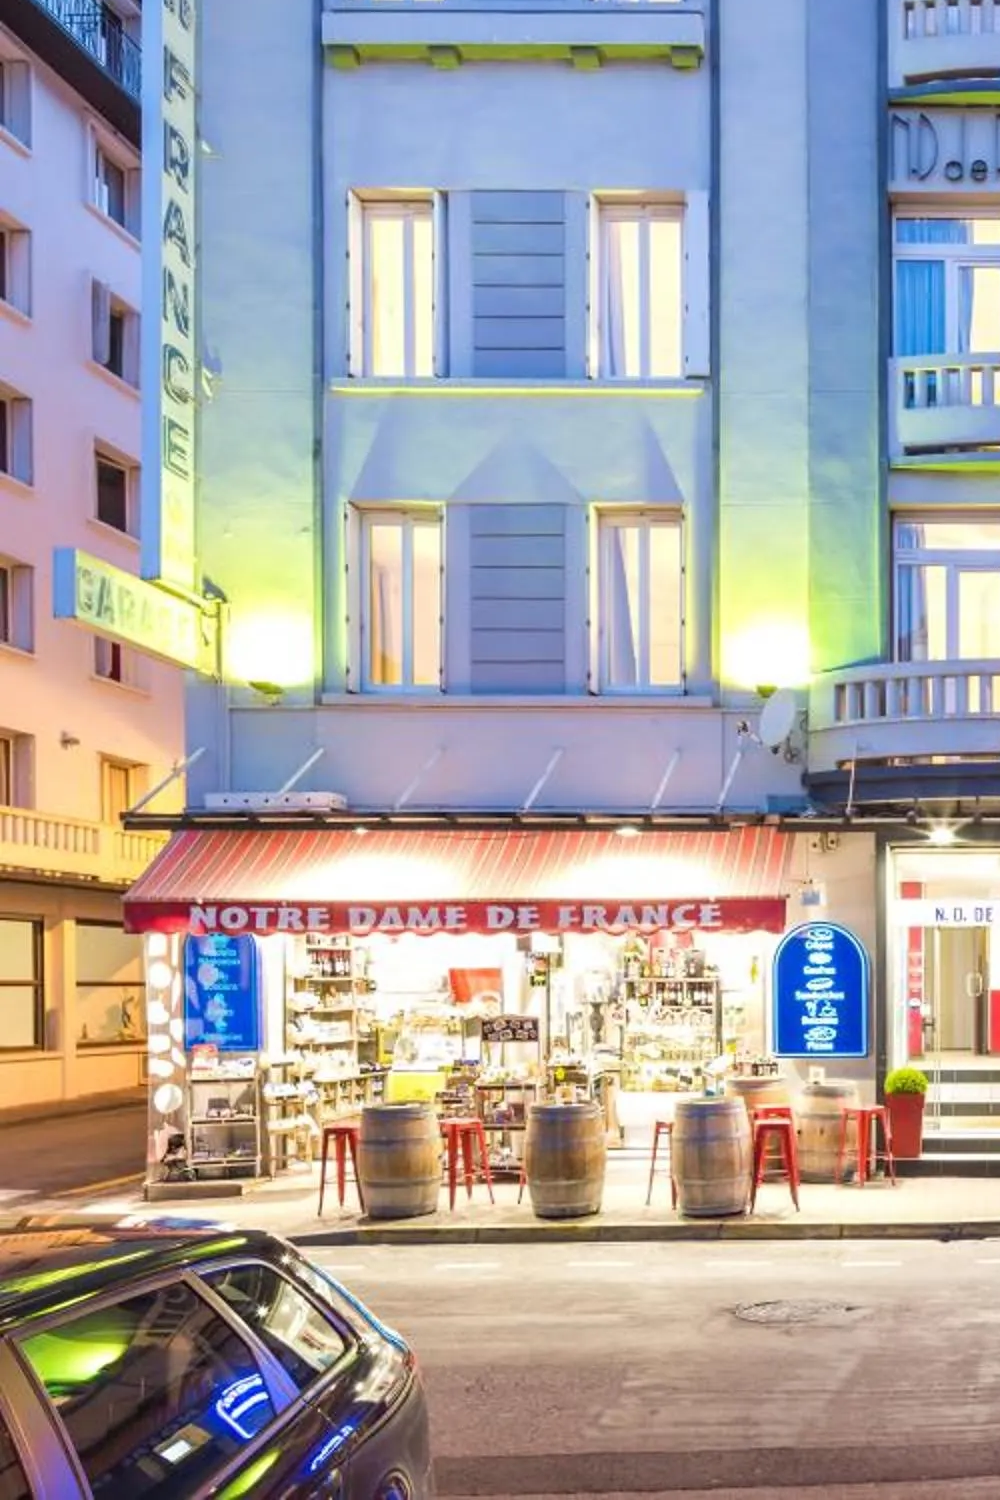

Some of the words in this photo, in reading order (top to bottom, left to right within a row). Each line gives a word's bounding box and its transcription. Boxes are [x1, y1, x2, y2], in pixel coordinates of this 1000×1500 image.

[163, 43, 191, 482] FRANCE
[189, 905, 330, 930] NOTRE
[349, 906, 467, 929] DAME
[486, 905, 539, 929] DE
[558, 903, 722, 928] FRANCE
[974, 907, 993, 922] DE
